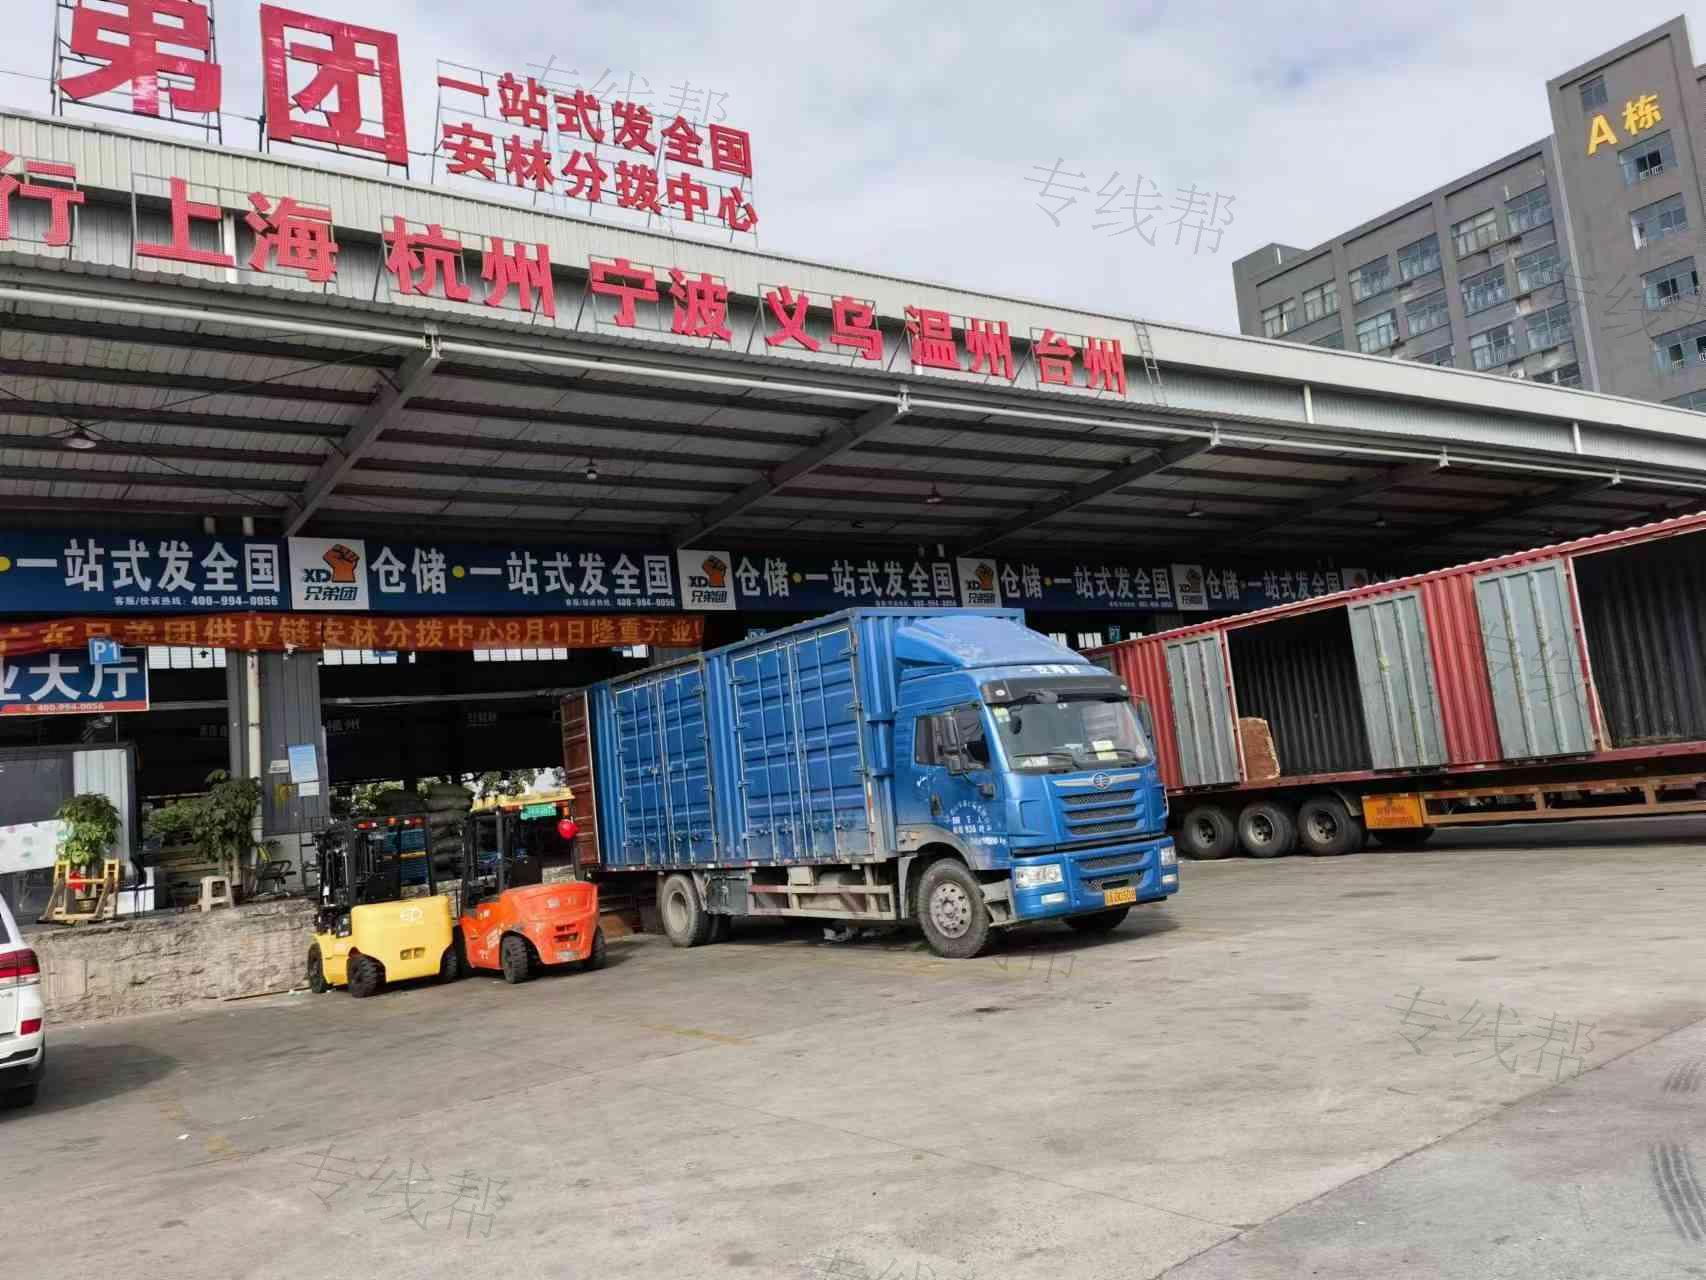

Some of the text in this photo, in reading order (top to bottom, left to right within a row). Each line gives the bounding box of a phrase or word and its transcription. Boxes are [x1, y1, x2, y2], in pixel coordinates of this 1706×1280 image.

[437, 72, 753, 178] 一站式发全国
[442, 122, 759, 232] 安林分拨中心
[303, 586, 358, 601] 兄弟团
